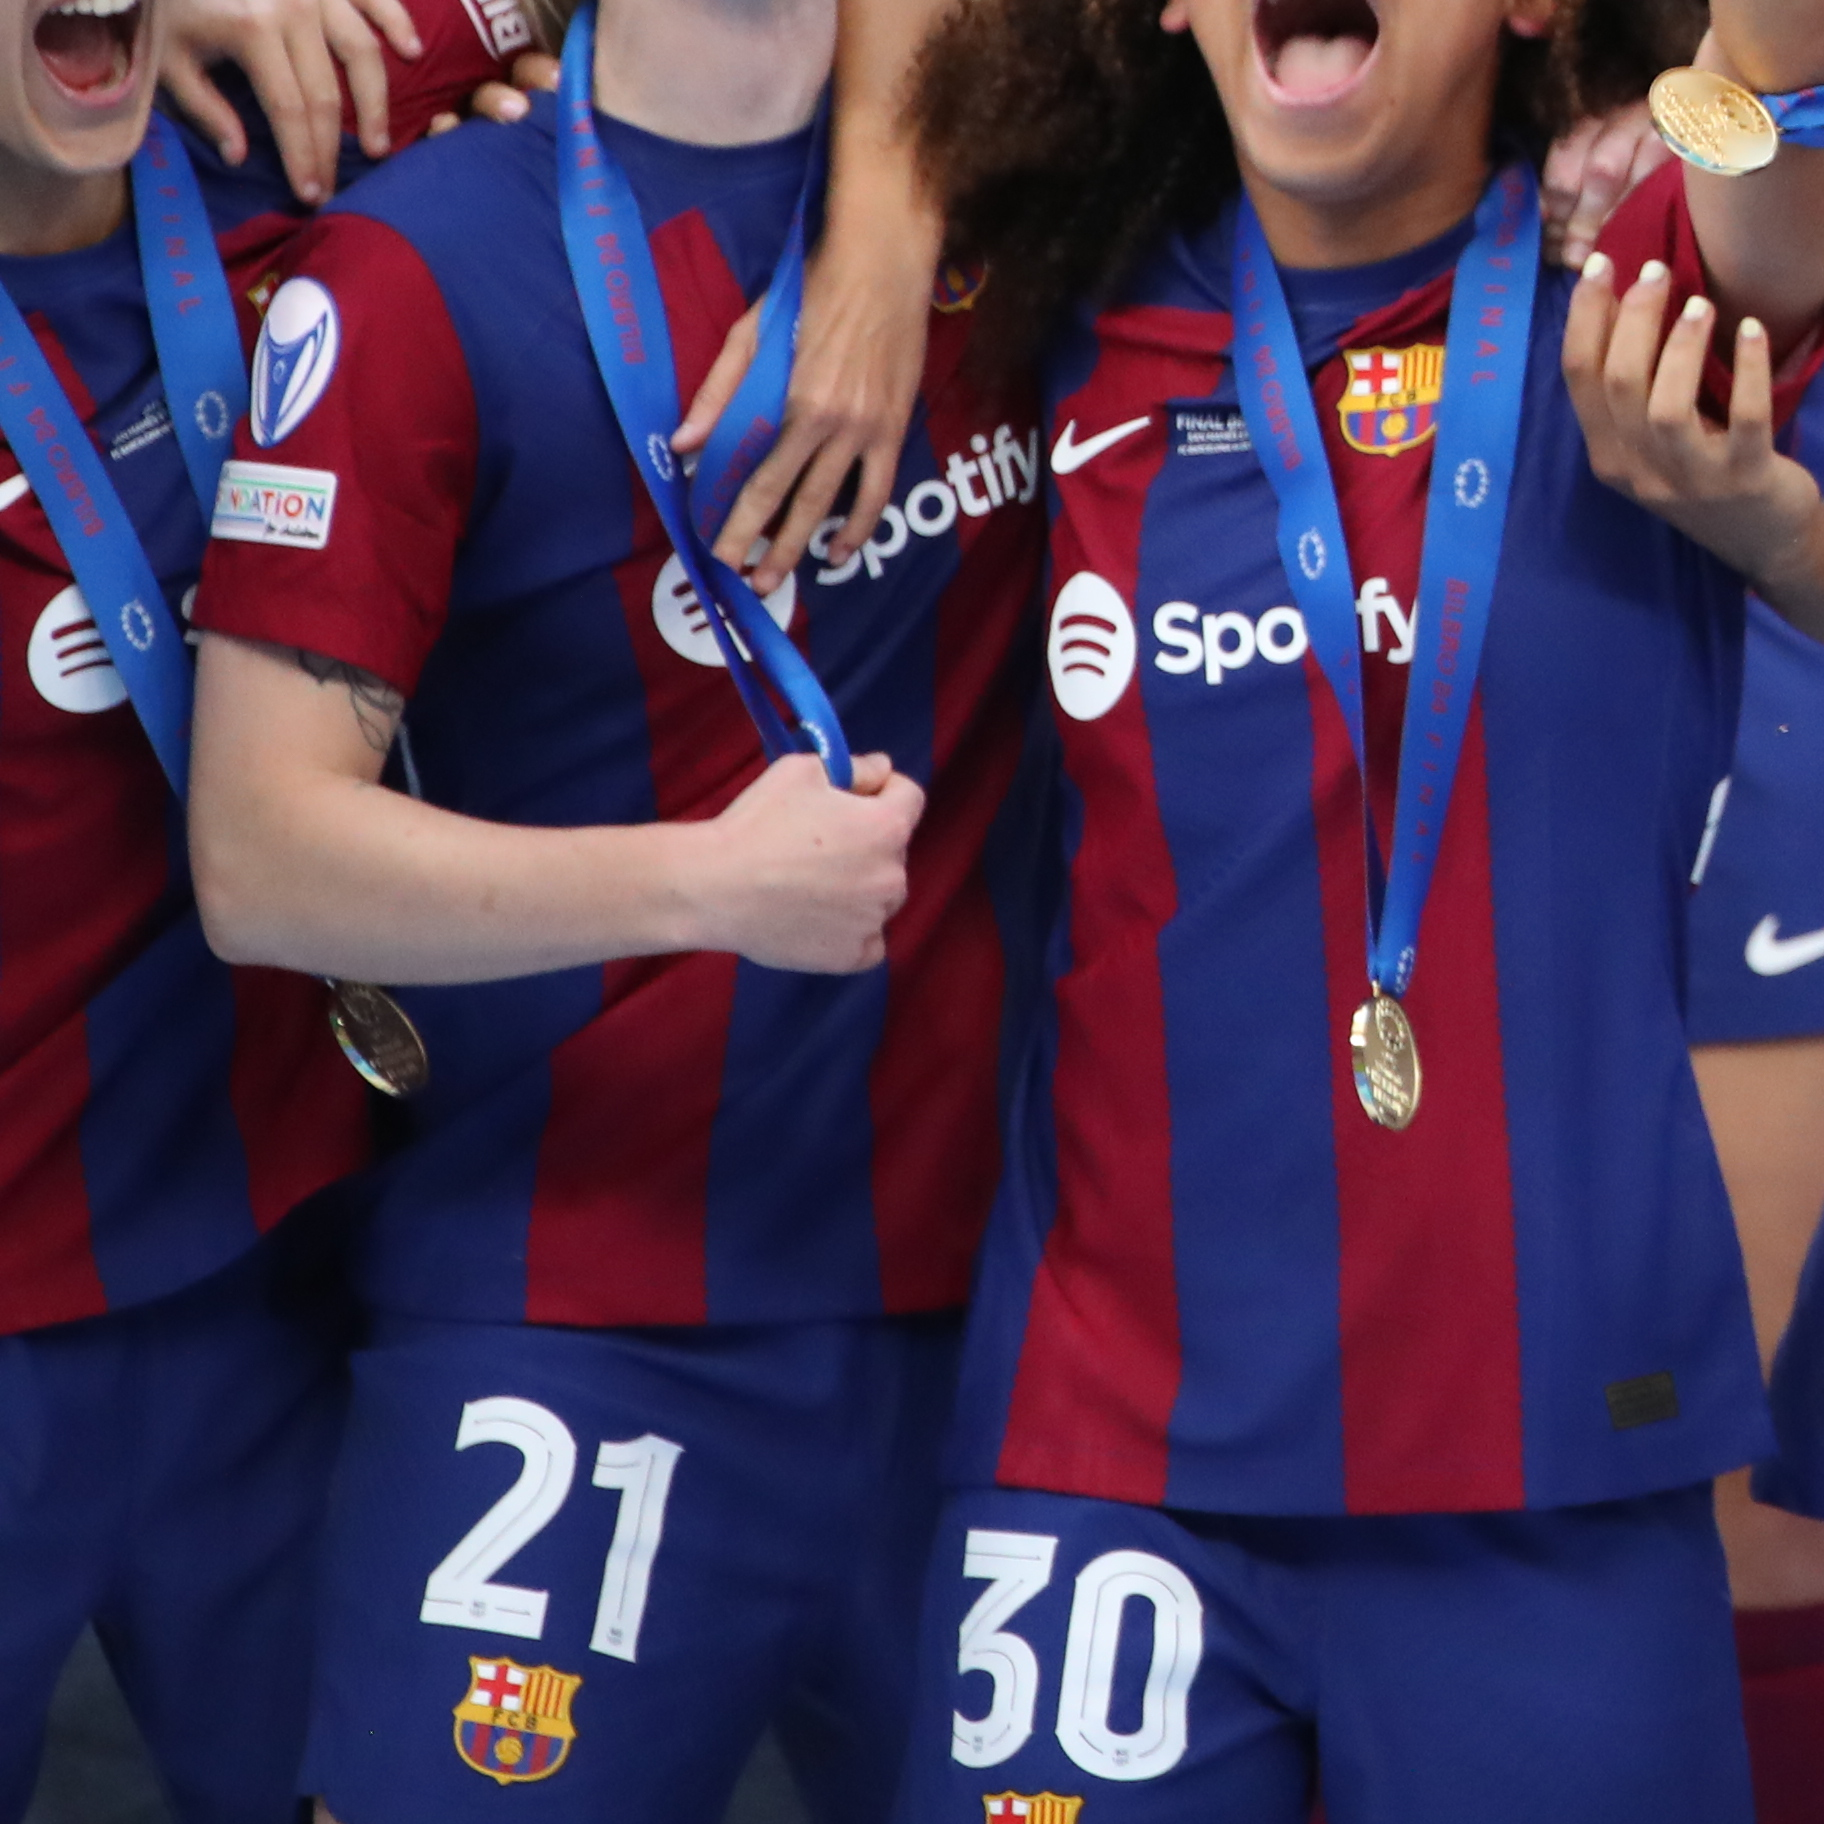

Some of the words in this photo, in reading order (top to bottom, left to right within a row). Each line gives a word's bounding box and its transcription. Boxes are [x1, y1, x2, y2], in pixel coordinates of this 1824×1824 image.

[1469, 255, 1513, 386] FINAL
[1153, 576, 1417, 685] Spofy
[420, 1396, 684, 1663] 21
[491, 1708, 538, 1732] FCB
[952, 1529, 1203, 1781] 30
